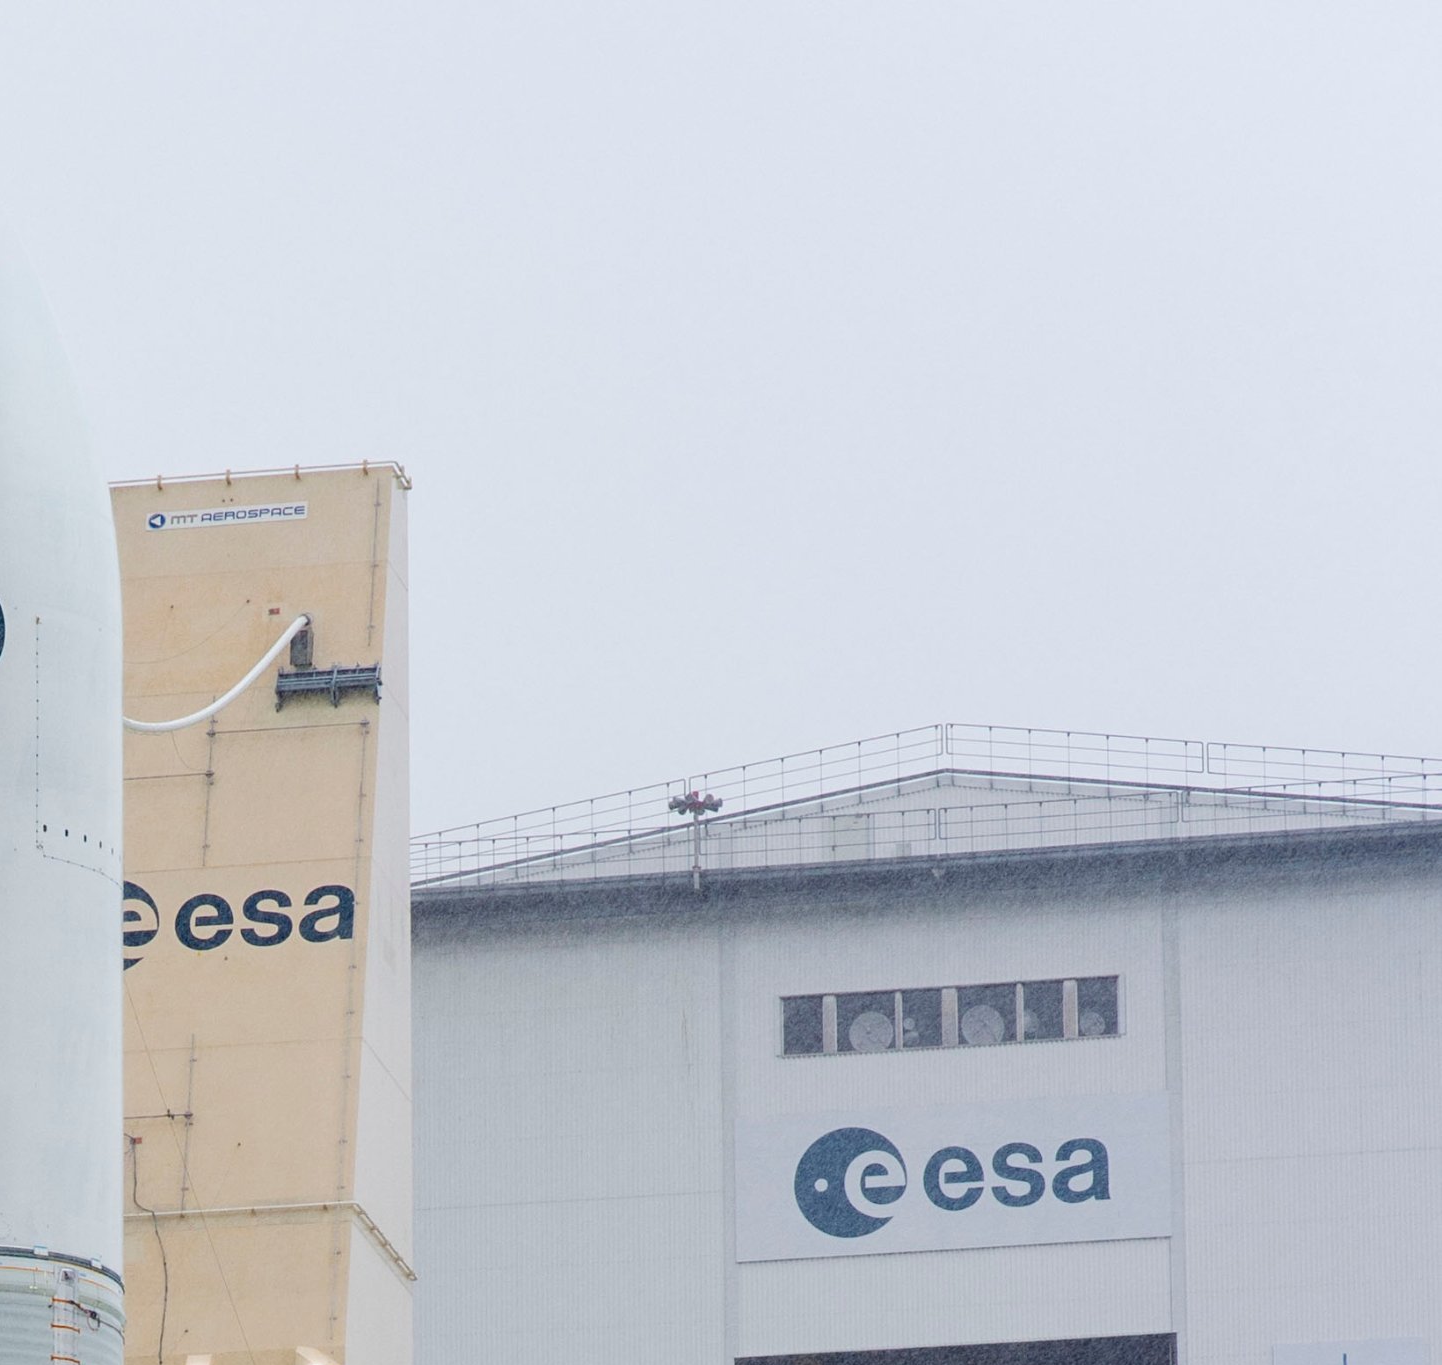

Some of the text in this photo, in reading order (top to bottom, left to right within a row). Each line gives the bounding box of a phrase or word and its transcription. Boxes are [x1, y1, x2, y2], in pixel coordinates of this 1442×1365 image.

[170, 505, 306, 525] MT AEROSPACE
[174, 884, 356, 951] esa
[921, 1136, 1112, 1213] esa
